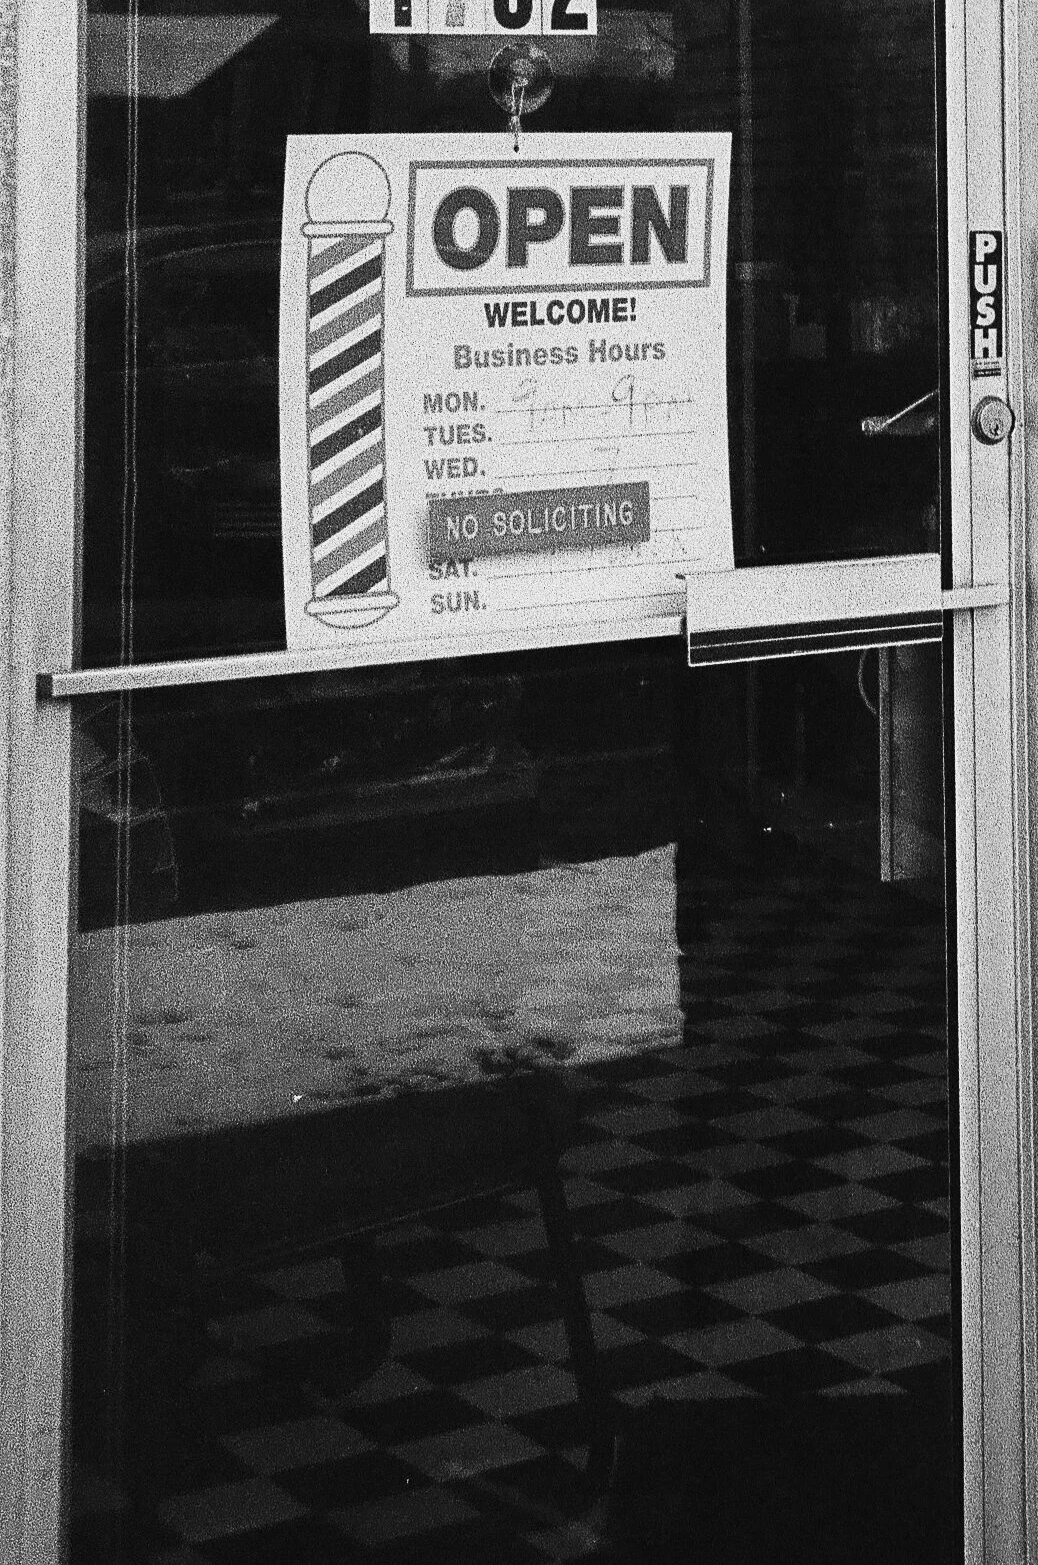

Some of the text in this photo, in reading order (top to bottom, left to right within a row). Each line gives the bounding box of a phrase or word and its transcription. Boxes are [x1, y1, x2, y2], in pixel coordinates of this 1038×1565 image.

[432, 183, 691, 272] OPEN
[973, 232, 998, 359] PUSH
[484, 297, 637, 328] WELCOME!
[453, 339, 667, 370] Business Hours
[423, 390, 486, 414] MON.
[424, 423, 493, 447] TUES.
[424, 457, 486, 481] WED.
[446, 500, 634, 540] NO SOLICITING
[428, 556, 479, 581] SAT.
[430, 590, 487, 615] SUN.
